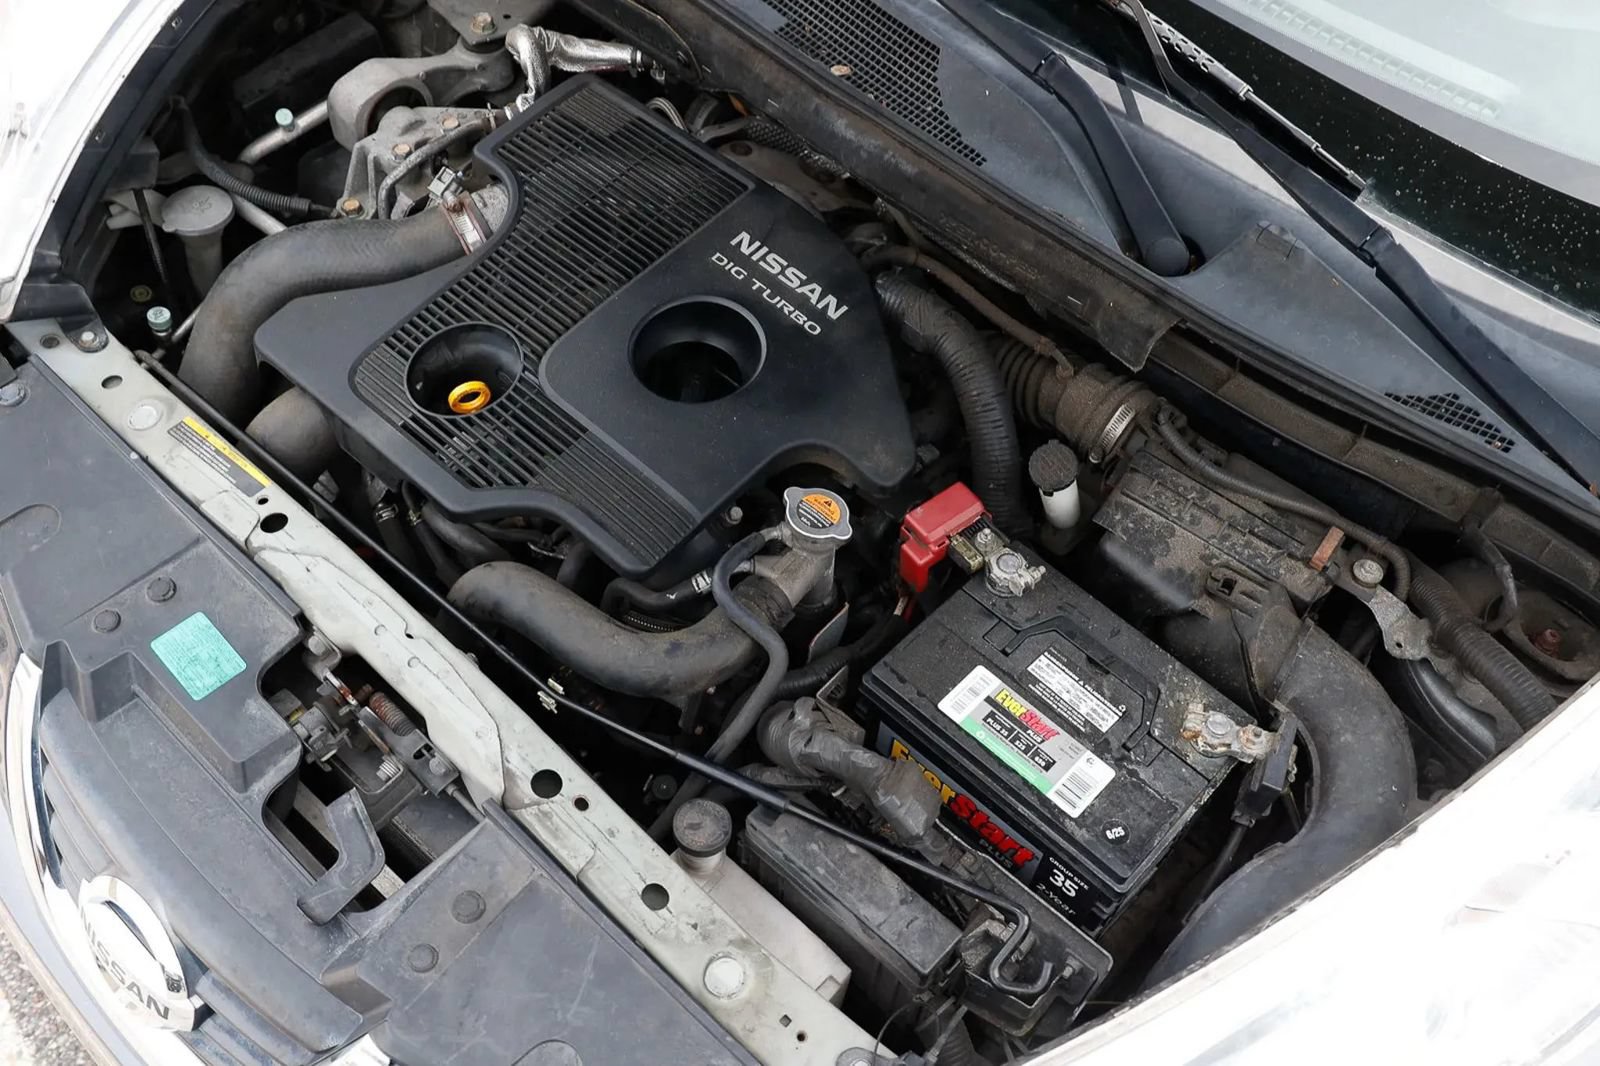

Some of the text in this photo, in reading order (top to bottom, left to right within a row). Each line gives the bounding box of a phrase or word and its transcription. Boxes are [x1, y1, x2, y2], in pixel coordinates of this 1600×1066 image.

[730, 231, 849, 321] NISSAN
[711, 252, 822, 335] DIG TURBO
[986, 717, 1002, 731] PLUS
[995, 688, 1060, 741] EverStart
[1026, 729, 1043, 743] PLUS
[890, 739, 1036, 868] EerStart
[1105, 826, 1126, 840] 6/25
[1049, 857, 1090, 891] GROUP SIZE
[1049, 868, 1081, 898] 35
[1036, 883, 1077, 916] 2-Year
[80, 905, 170, 1020] NISSAN
